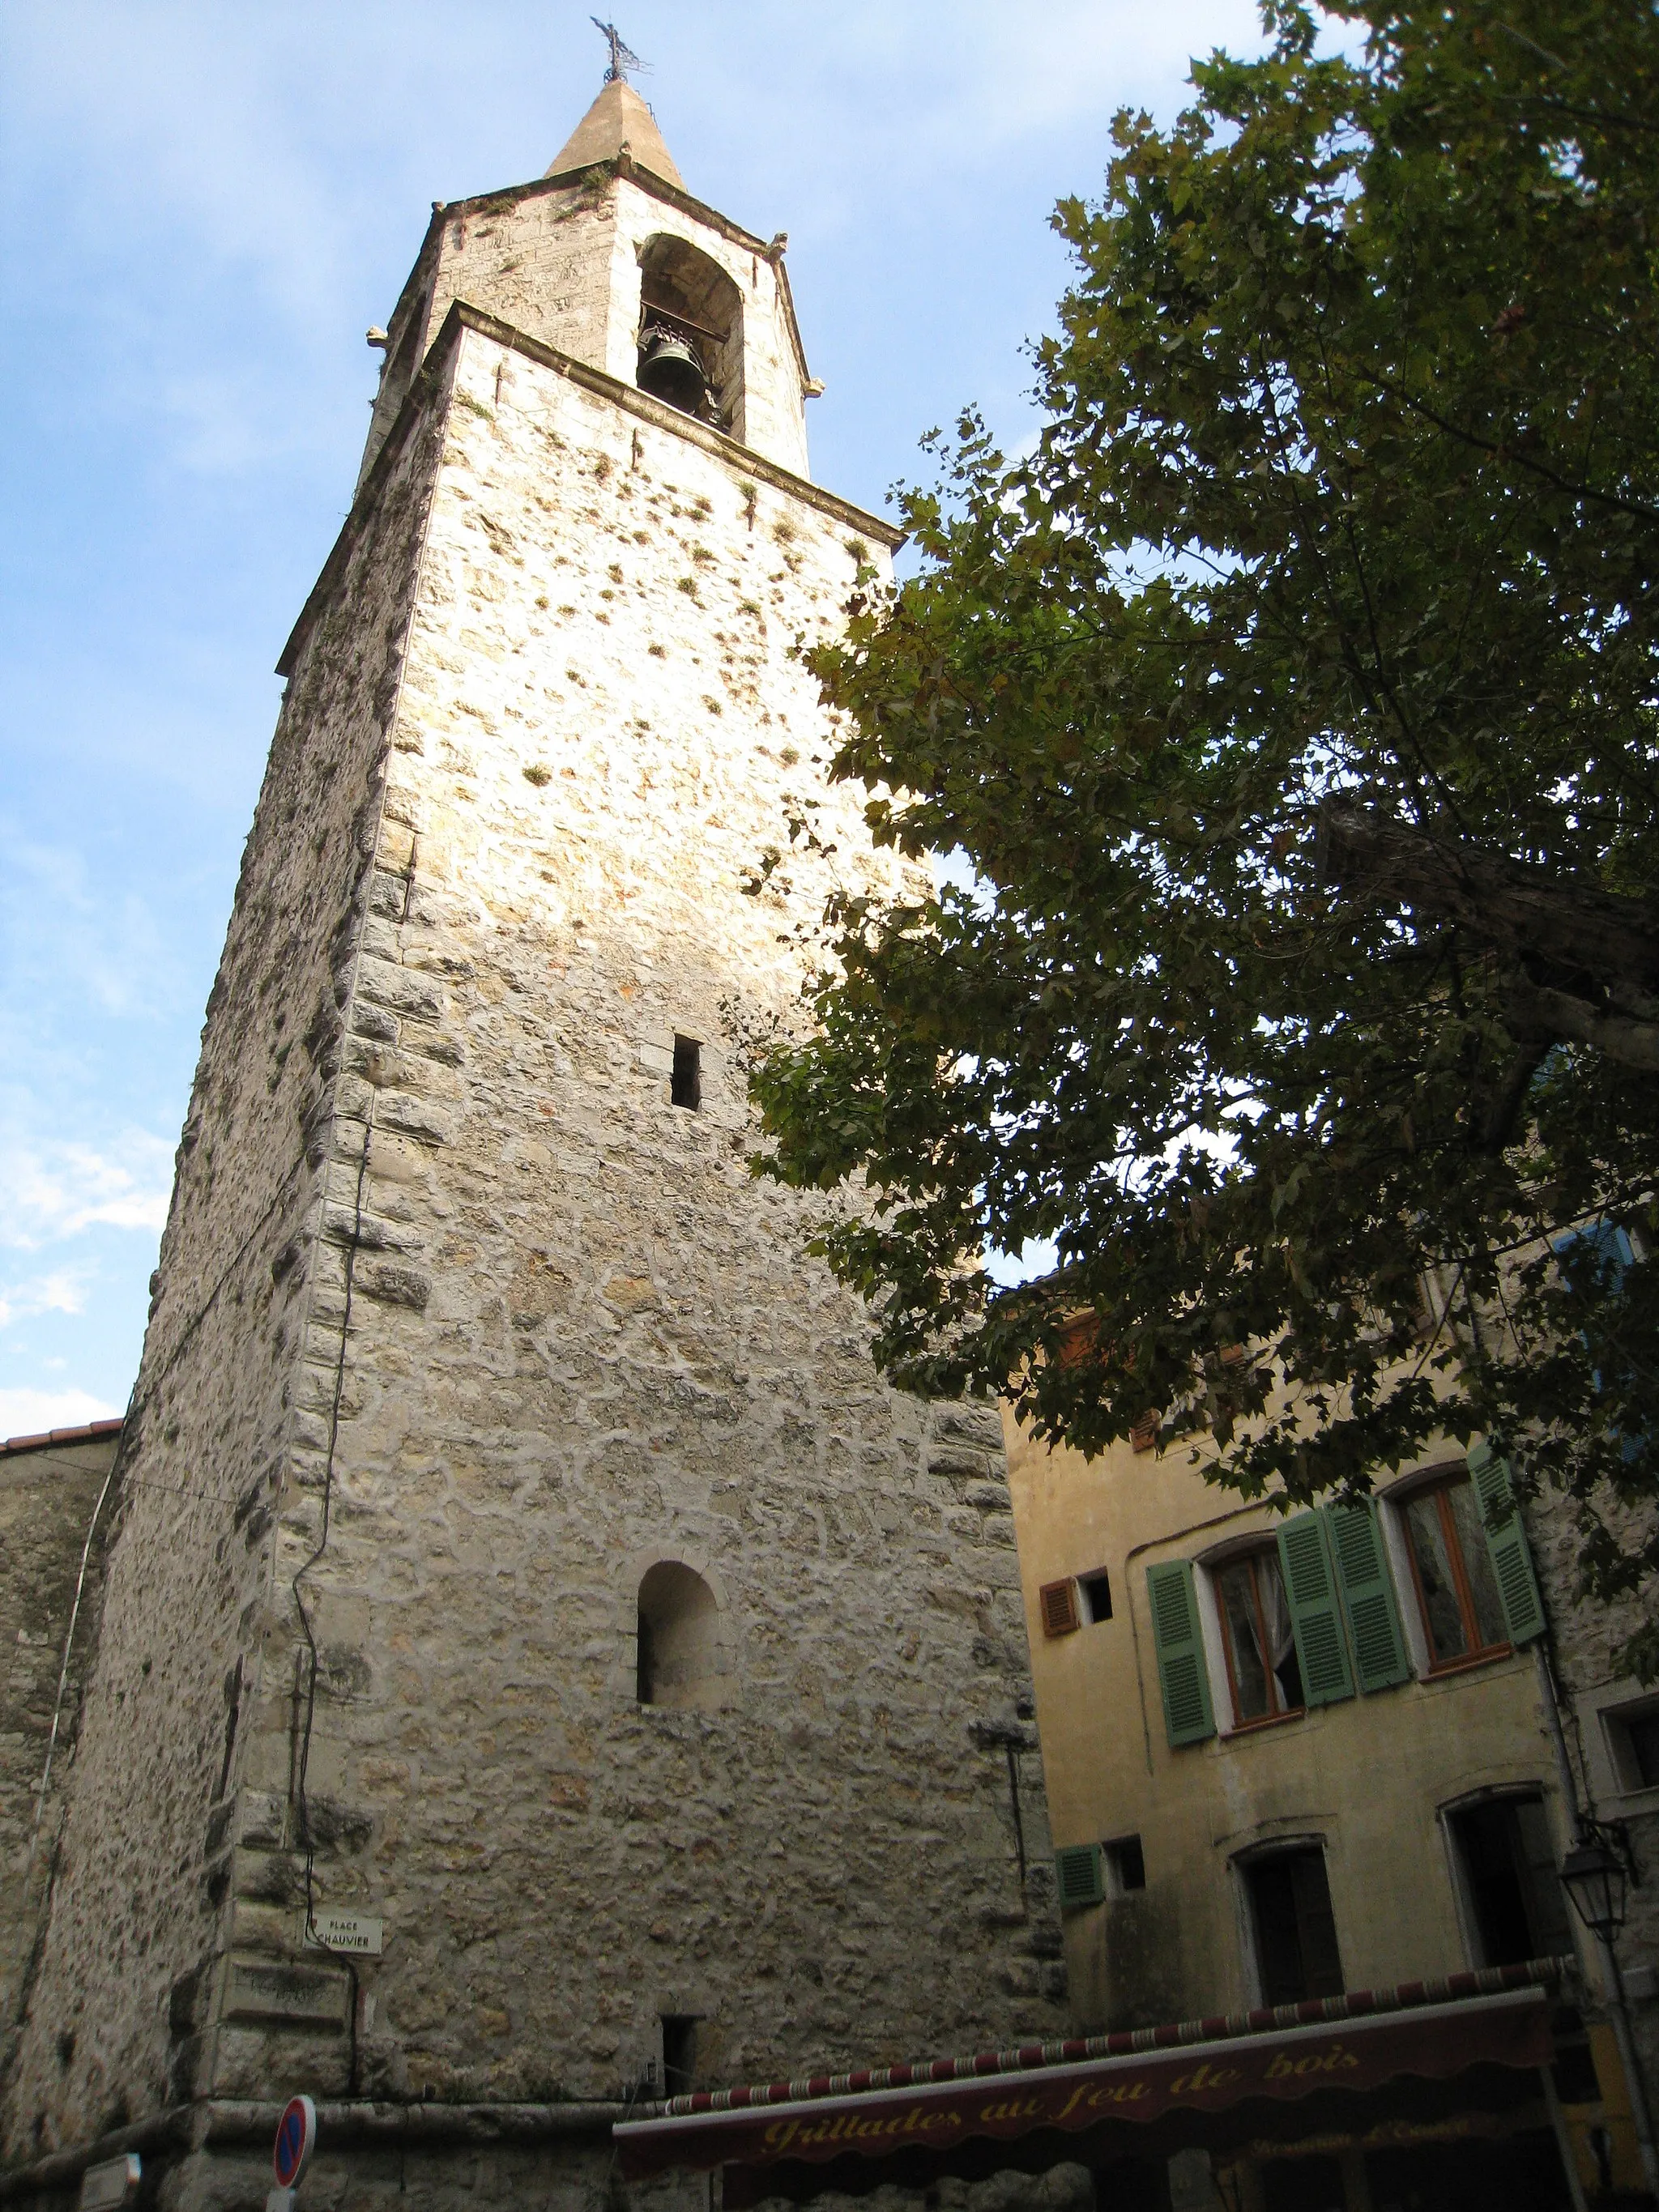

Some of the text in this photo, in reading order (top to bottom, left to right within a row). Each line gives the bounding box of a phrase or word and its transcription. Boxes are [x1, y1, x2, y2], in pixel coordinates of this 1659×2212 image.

[330, 1920, 357, 1930] PLACE
[318, 1933, 369, 1947] CHAUVIER
[761, 2043, 1360, 2153] Grillades au feu de bois
